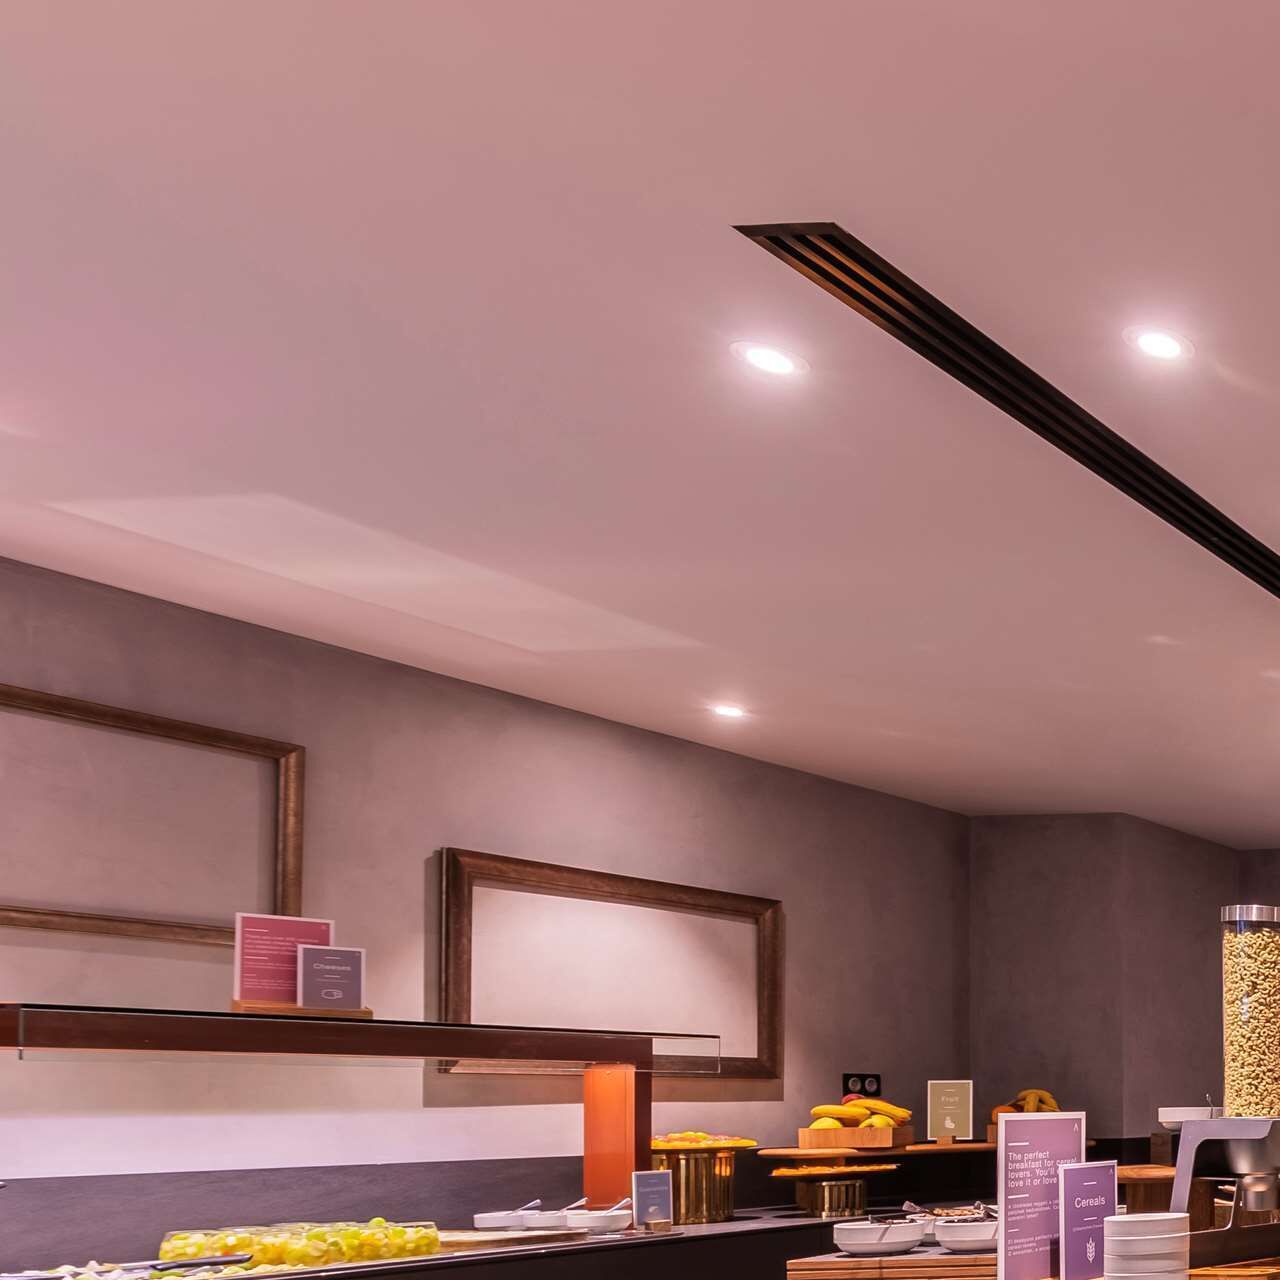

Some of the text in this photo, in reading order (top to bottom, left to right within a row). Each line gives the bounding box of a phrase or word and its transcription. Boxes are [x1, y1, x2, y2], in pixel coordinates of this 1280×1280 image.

[1008, 1151, 1050, 1162] The perfect
[1008, 1159, 1042, 1170] breakfast
[1044, 1159, 1054, 1167] for
[1008, 1170, 1033, 1179] lovers.
[1035, 1167, 1055, 1177] You'll
[1008, 1176, 1058, 1188] love it or love
[1074, 1195, 1106, 1208] Cereals
